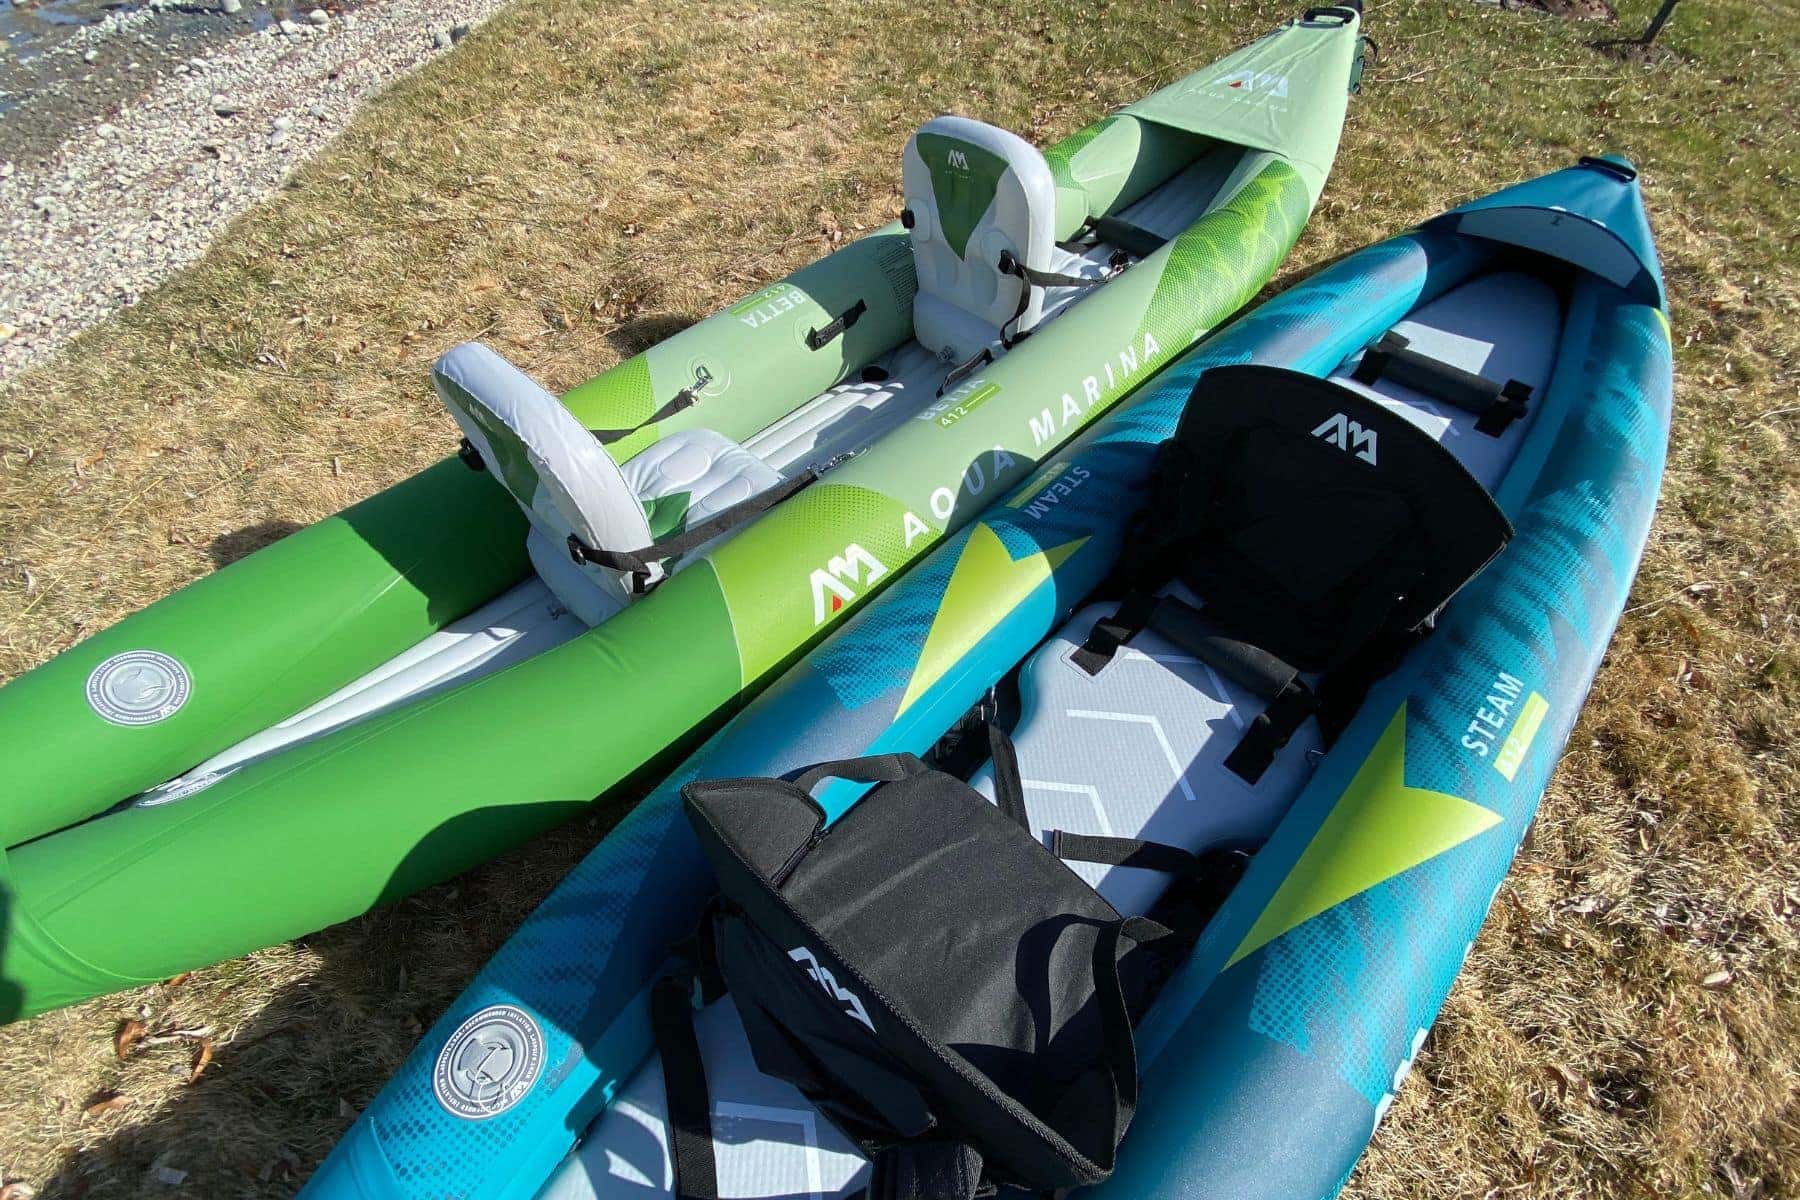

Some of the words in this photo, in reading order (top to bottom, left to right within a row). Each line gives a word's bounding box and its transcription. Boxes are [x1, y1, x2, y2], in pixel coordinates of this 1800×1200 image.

[740, 289, 806, 329] BETTA
[903, 445, 1016, 549] AQUA
[1028, 332, 1162, 447] MARINA
[941, 406, 969, 427] 412
[1023, 466, 1091, 520] STEAM
[1460, 671, 1525, 758] STEAM
